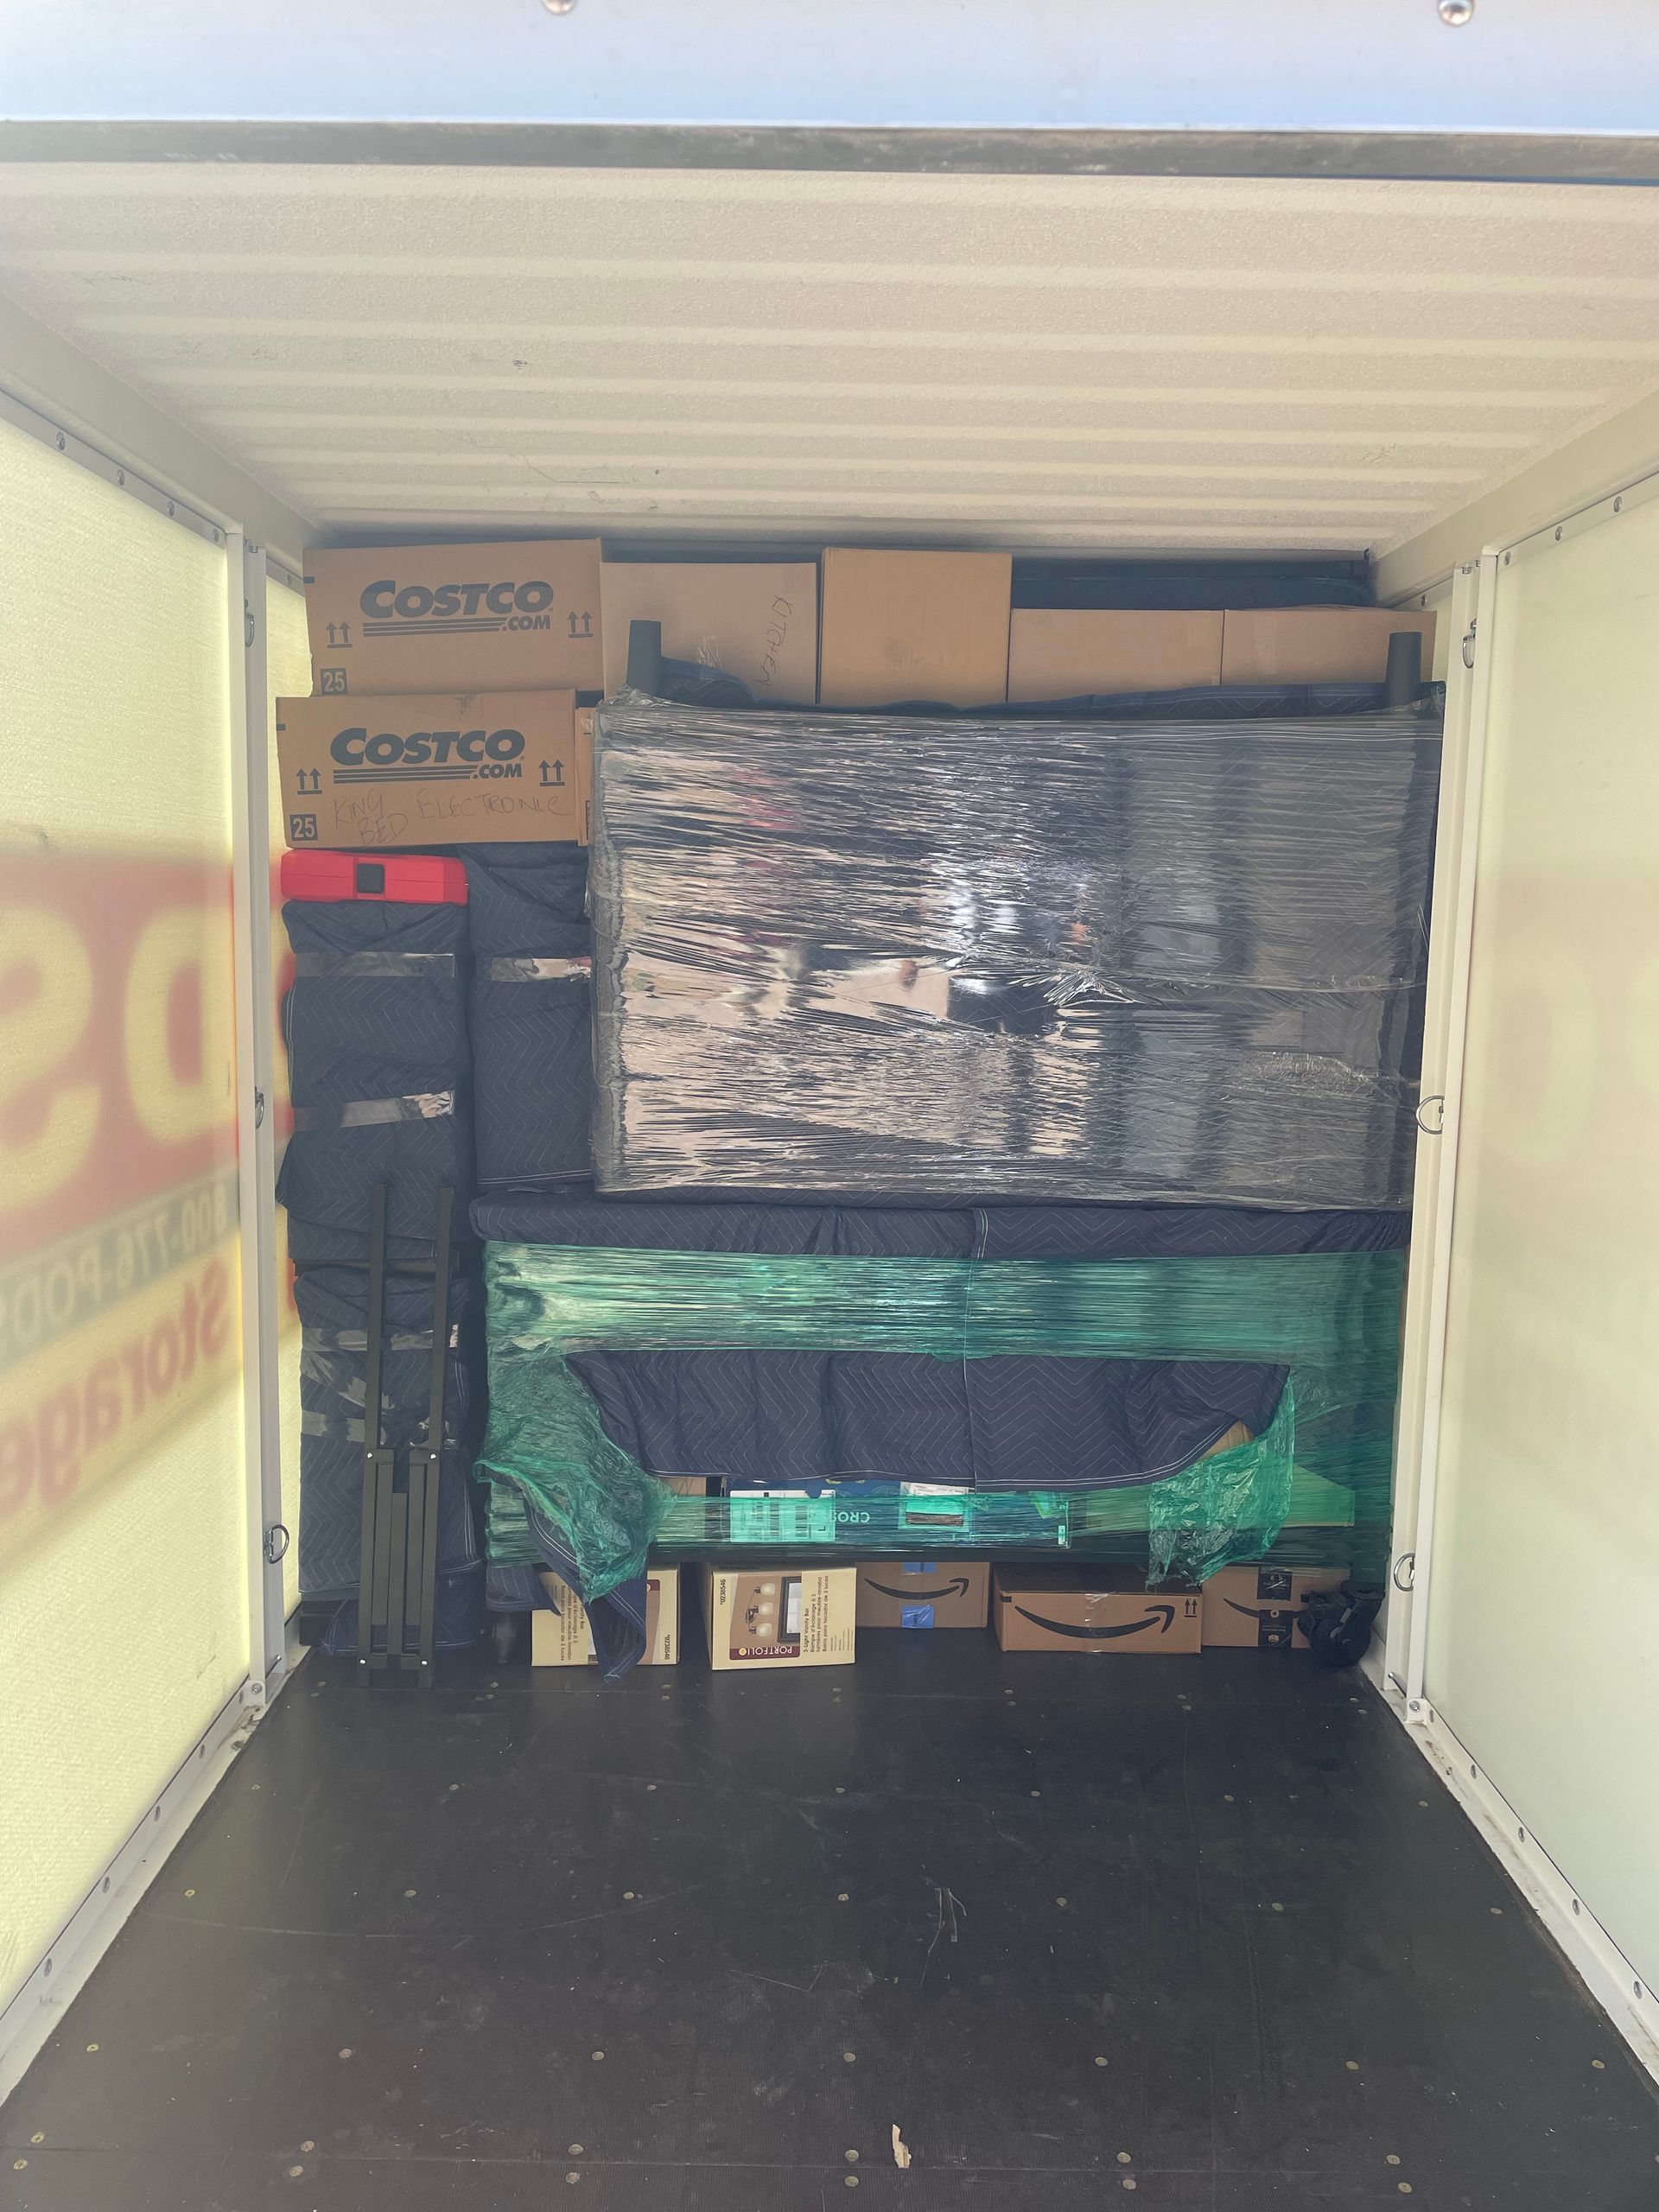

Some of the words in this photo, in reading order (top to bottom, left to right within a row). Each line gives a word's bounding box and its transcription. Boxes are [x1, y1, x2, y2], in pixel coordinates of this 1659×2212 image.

[359, 580, 554, 619] COSTCO
[753, 595, 792, 685] KITCHEN
[322, 671, 345, 692] 25
[330, 728, 525, 766] COSTCO
[334, 788, 383, 830] KING
[292, 817, 315, 838] 25
[357, 812, 408, 847] BED
[834, 1511, 870, 1523] CRO
